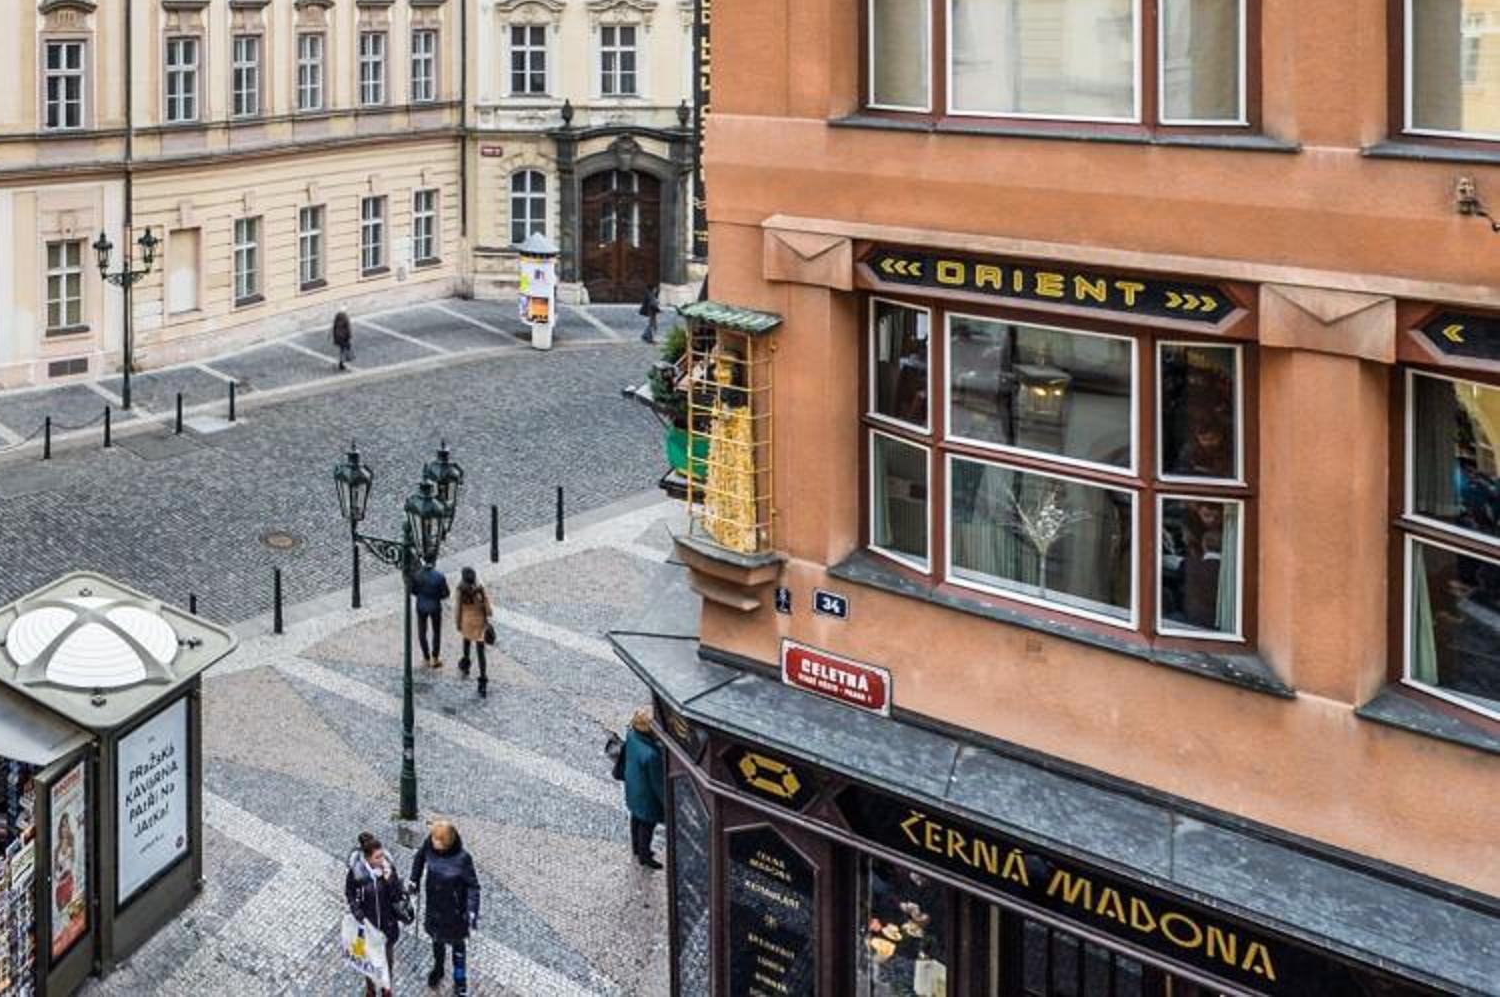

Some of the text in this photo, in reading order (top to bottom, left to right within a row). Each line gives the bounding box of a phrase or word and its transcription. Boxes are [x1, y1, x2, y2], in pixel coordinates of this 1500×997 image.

[936, 259, 1146, 306] ORIENT
[821, 595, 841, 614] 34
[900, 809, 1277, 982] ČERNÁ MADONA
